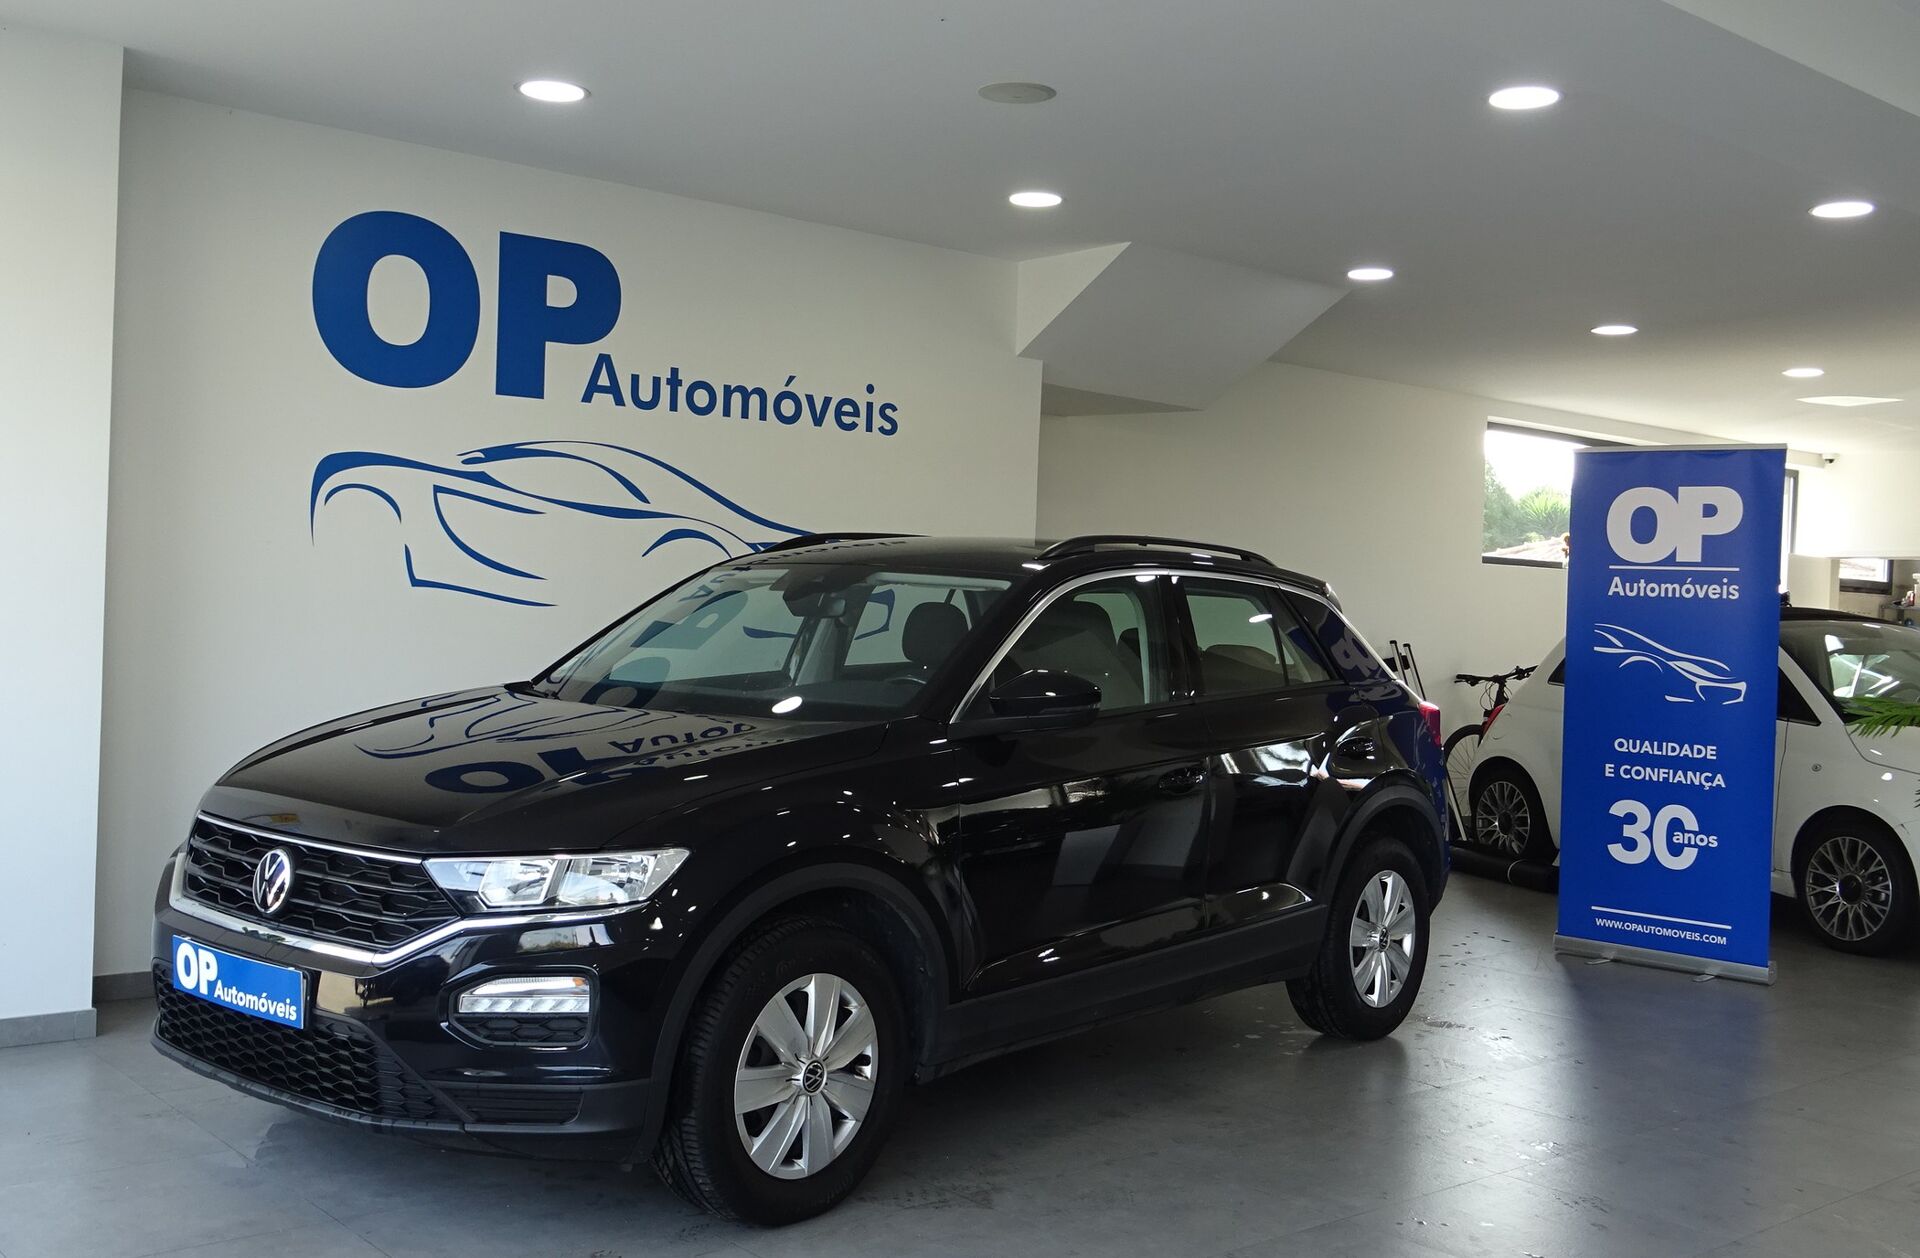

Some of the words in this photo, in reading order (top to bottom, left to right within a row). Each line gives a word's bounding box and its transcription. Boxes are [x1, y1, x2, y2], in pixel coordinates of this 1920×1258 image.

[311, 210, 621, 400] OP
[581, 353, 898, 437] Automóveis
[1607, 486, 1744, 564] OP
[1608, 577, 1740, 600] Automóveis
[1614, 738, 1717, 760] QUALIDADE
[1605, 764, 1615, 777] E
[1620, 765, 1726, 790] CONFIANÇA
[1607, 799, 1699, 871] 30
[1673, 830, 1718, 848] anos
[1596, 918, 1728, 945] WWW.OPAUTOMOVEIS.COM
[176, 942, 218, 995] OP
[214, 979, 297, 1021] Automóveis
